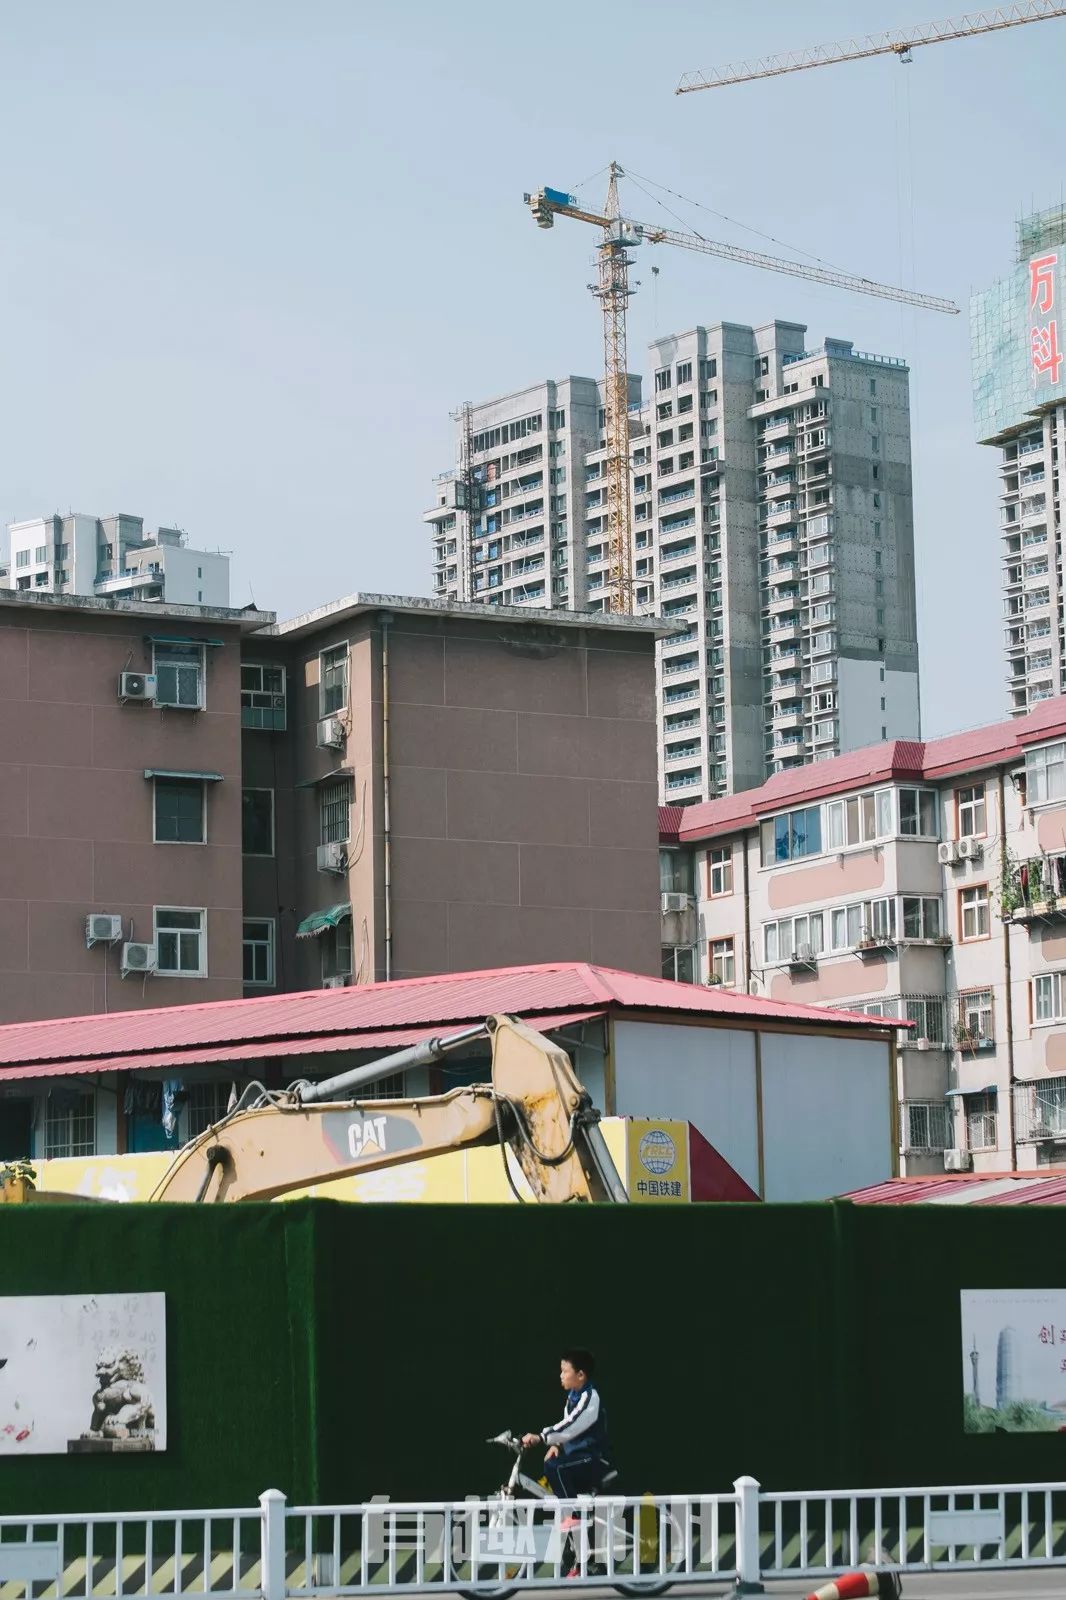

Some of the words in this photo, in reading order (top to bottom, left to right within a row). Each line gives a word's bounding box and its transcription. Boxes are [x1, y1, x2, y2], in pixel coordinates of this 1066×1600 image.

[1029, 254, 1063, 385] 万科
[348, 1116, 387, 1158] CAT
[637, 1180, 681, 1196] 中国铁建
